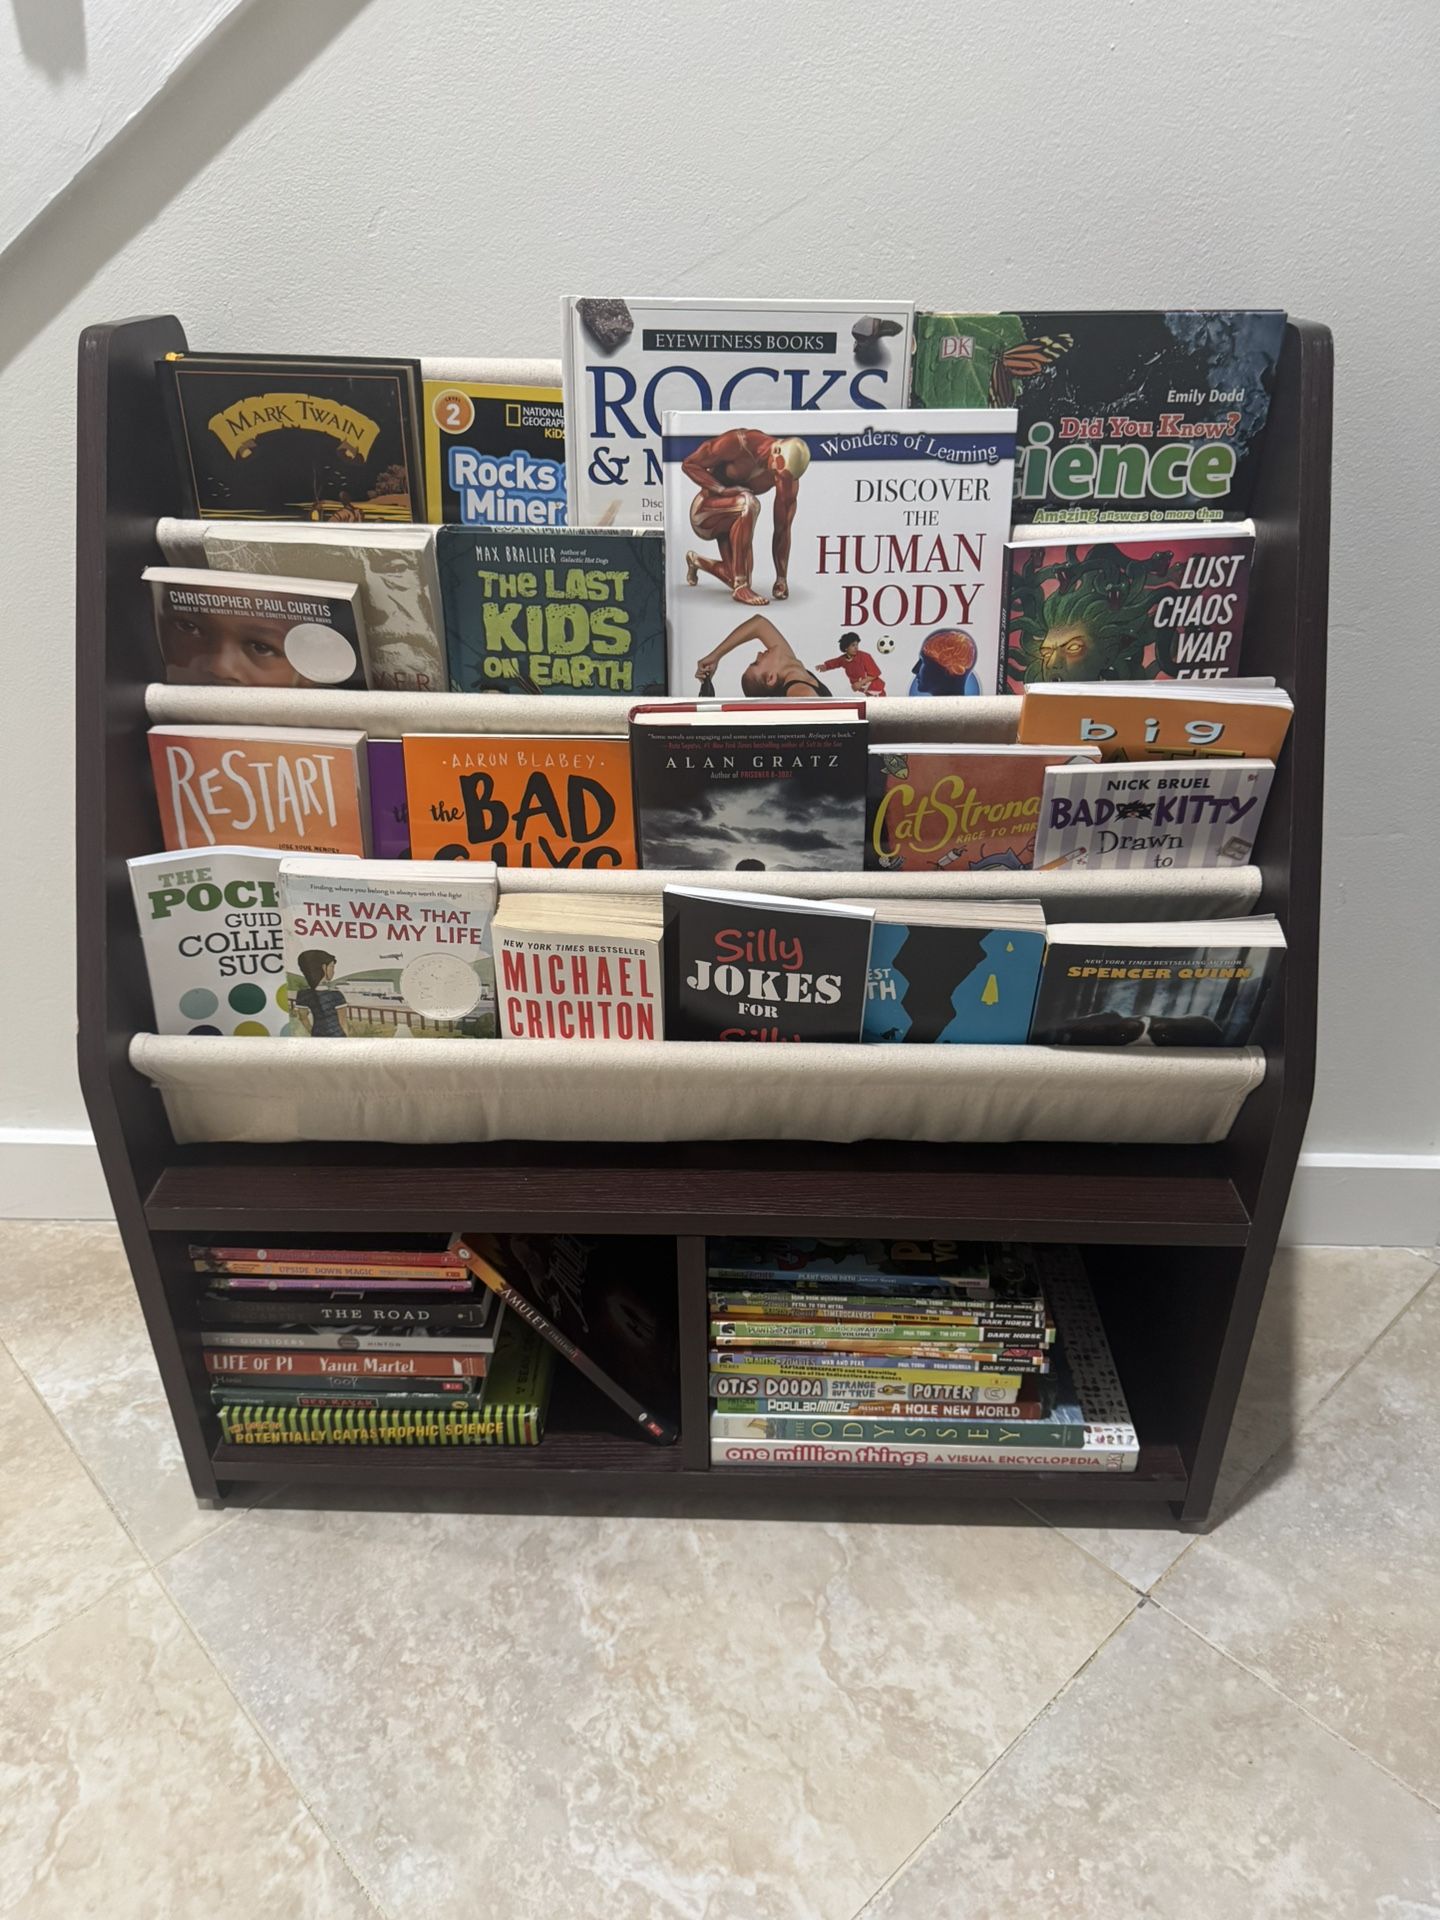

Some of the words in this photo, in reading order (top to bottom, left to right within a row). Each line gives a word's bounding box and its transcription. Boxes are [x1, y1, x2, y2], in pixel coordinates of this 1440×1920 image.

[656, 334, 762, 350] EYEWITNESS
[767, 335, 824, 350] BOOKS
[943, 338, 971, 356] DK
[586, 365, 889, 439] ROCKS
[1167, 389, 1205, 405] Emily
[1209, 388, 1244, 402] Dodd
[226, 403, 288, 438] MARK
[295, 400, 365, 440] TWAIN
[446, 403, 460, 425] 2
[523, 406, 564, 417] NATIONAL
[1060, 418, 1103, 438] Did
[1109, 417, 1153, 438] You
[1157, 412, 1241, 438] Know?
[820, 430, 899, 458] Wonders
[904, 432, 923, 450] of
[925, 441, 998, 464] Learning
[454, 453, 556, 491] Rocks
[588, 446, 630, 486] &
[855, 478, 991, 503] DISCOVER
[466, 488, 568, 524] Miner
[642, 512, 651, 521] in
[1033, 508, 1098, 524] Amazing
[1101, 509, 1148, 522] answers
[1150, 510, 1163, 521] to
[1165, 509, 1195, 520] more
[1197, 508, 1223, 520] than
[903, 510, 939, 526] THE
[476, 546, 500, 562] MAX
[505, 546, 557, 564] BRALLIER
[816, 533, 987, 575] HUMAN
[1180, 555, 1245, 589] LUST
[545, 569, 630, 601] LAST
[169, 590, 251, 609] CHRISTOPHER
[255, 598, 286, 613] PAUL
[287, 601, 331, 617] CURTIS
[841, 584, 985, 627] BODY
[1153, 594, 1238, 628] CHAOS
[482, 603, 632, 655] KIDS
[1176, 631, 1233, 663] WAR
[483, 656, 520, 679] ON
[529, 655, 633, 690] EARTH
[1080, 718, 1226, 745] big
[452, 752, 508, 768] AARON
[518, 752, 596, 768] BLABEY
[665, 756, 735, 768] ALAN
[753, 755, 839, 768] GRATZ
[1106, 779, 1150, 791] NICK
[1157, 778, 1211, 790] BRUEL
[429, 801, 465, 822] the
[459, 771, 616, 845] BAD
[1050, 798, 1116, 829] BAD
[1153, 795, 1258, 827] KITTY
[956, 830, 986, 844] RACE
[990, 827, 1007, 838] TO
[1096, 830, 1184, 855] Drawn
[1154, 855, 1173, 869] to
[158, 867, 212, 888] THE
[303, 902, 341, 918] THE
[349, 901, 412, 921] WAR
[420, 908, 471, 924] THAT
[294, 918, 378, 939] SAVED
[387, 924, 427, 942] MY
[436, 926, 482, 945] LIFE
[503, 939, 523, 948] NEW
[527, 942, 552, 951] YORK
[556, 944, 585, 952] TIMES
[588, 945, 646, 956] BESTSELLER
[714, 928, 804, 970] Silly
[502, 949, 654, 998] MICHAEL
[686, 959, 842, 1005] JOKES
[1067, 966, 1172, 979] SPENCER
[1178, 968, 1252, 979] QUINN
[507, 997, 654, 1040] CRICHTON
[738, 1002, 779, 1018] FOR
[321, 1309, 362, 1319] THE
[374, 1310, 430, 1320] ROAD
[501, 1288, 549, 1330] AMULET
[1004, 1319, 1032, 1327] HORSE
[987, 1331, 1011, 1339] DARK
[213, 1354, 249, 1369] LIFE
[253, 1357, 272, 1370] OF
[276, 1356, 293, 1371] PI
[319, 1356, 360, 1372] Yann
[363, 1357, 416, 1373] Martel
[765, 1378, 823, 1396] DOODA
[831, 1381, 876, 1389] STRANGE
[849, 1389, 875, 1398] TRUE
[912, 1384, 973, 1400] POTTER
[891, 1403, 899, 1414] A
[905, 1404, 938, 1415] HOLE
[943, 1405, 971, 1416] NEW
[975, 1406, 1021, 1417] WORLD
[235, 1430, 327, 1443] POTENTIALLY
[333, 1425, 440, 1441] CATASTROPHIC
[445, 1422, 504, 1435] SCIENCE
[811, 1421, 1021, 1441] ODYSSEY
[727, 1447, 769, 1461] one
[775, 1445, 851, 1462] million
[857, 1446, 929, 1466] things
[934, 1455, 943, 1463] A
[946, 1455, 995, 1463] VISUAL
[999, 1455, 1100, 1465] ENCYCLOPEDIA
